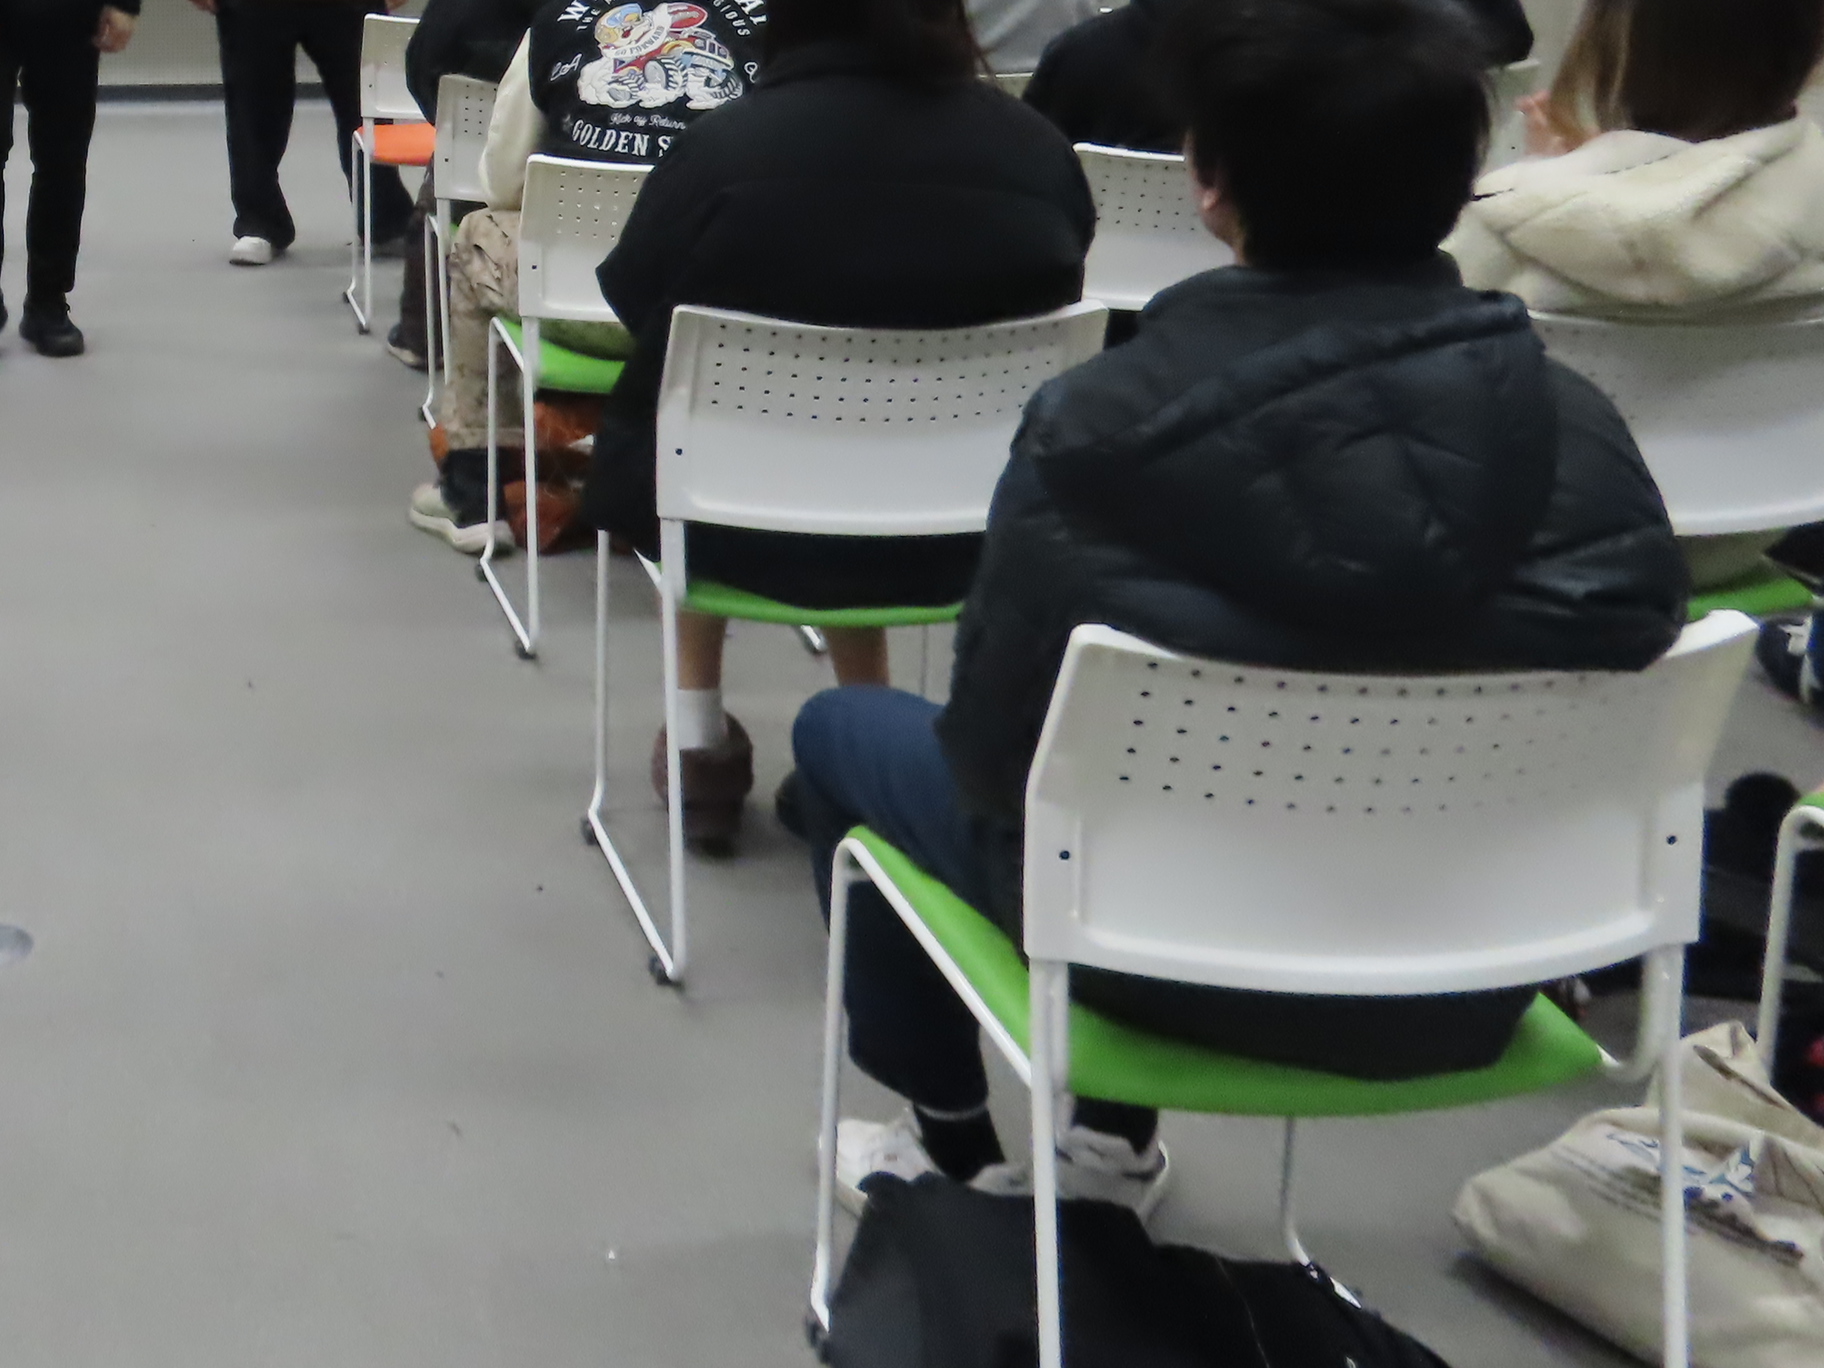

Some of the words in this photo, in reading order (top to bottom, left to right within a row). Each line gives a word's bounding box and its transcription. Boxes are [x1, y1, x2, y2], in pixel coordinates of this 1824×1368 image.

[629, 24, 665, 56] FORWARD
[572, 119, 650, 157] GOLDEN
[649, 114, 686, 130] Return
